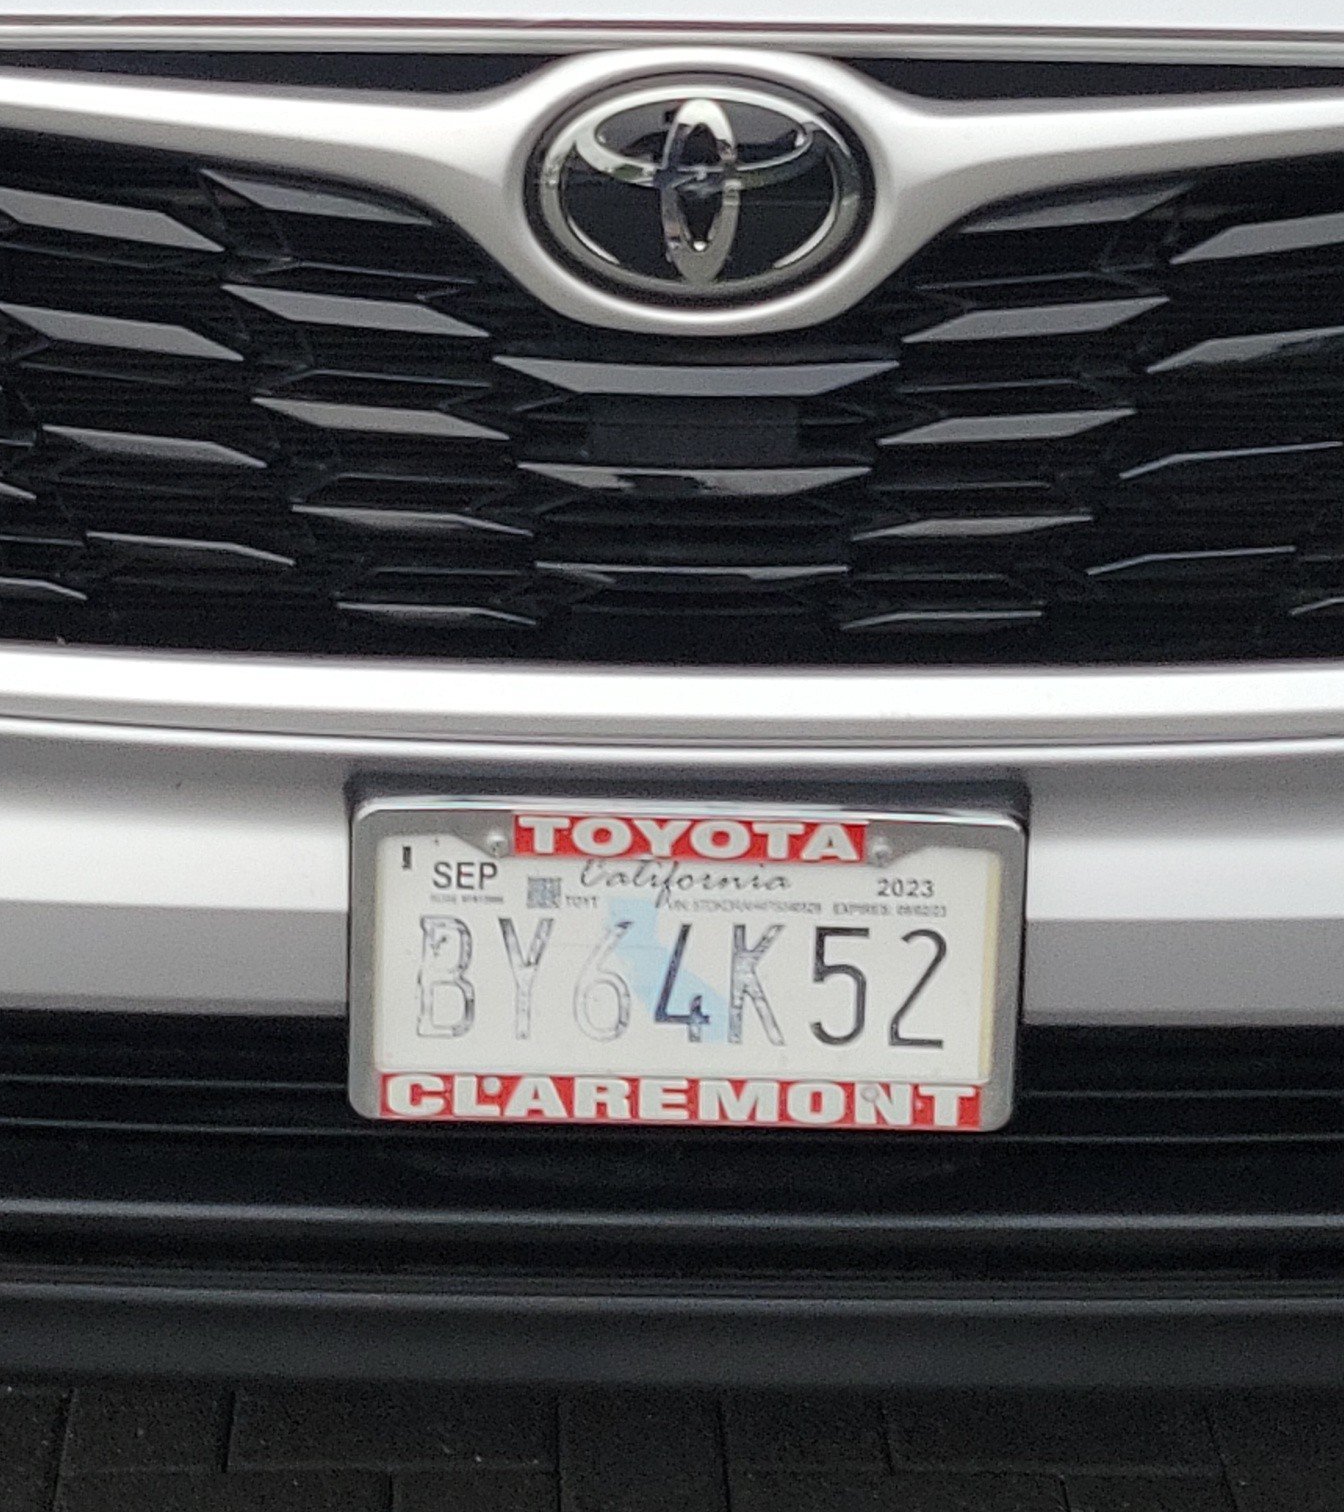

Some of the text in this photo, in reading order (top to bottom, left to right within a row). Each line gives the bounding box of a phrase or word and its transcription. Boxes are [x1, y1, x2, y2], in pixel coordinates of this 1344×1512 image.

[517, 815, 862, 862] TOYOTA
[433, 861, 498, 890] SEP
[580, 858, 792, 908] California
[877, 878, 935, 898] 2023
[416, 914, 948, 1050] BY64K52
[387, 1074, 980, 1128] CLAREMONT
